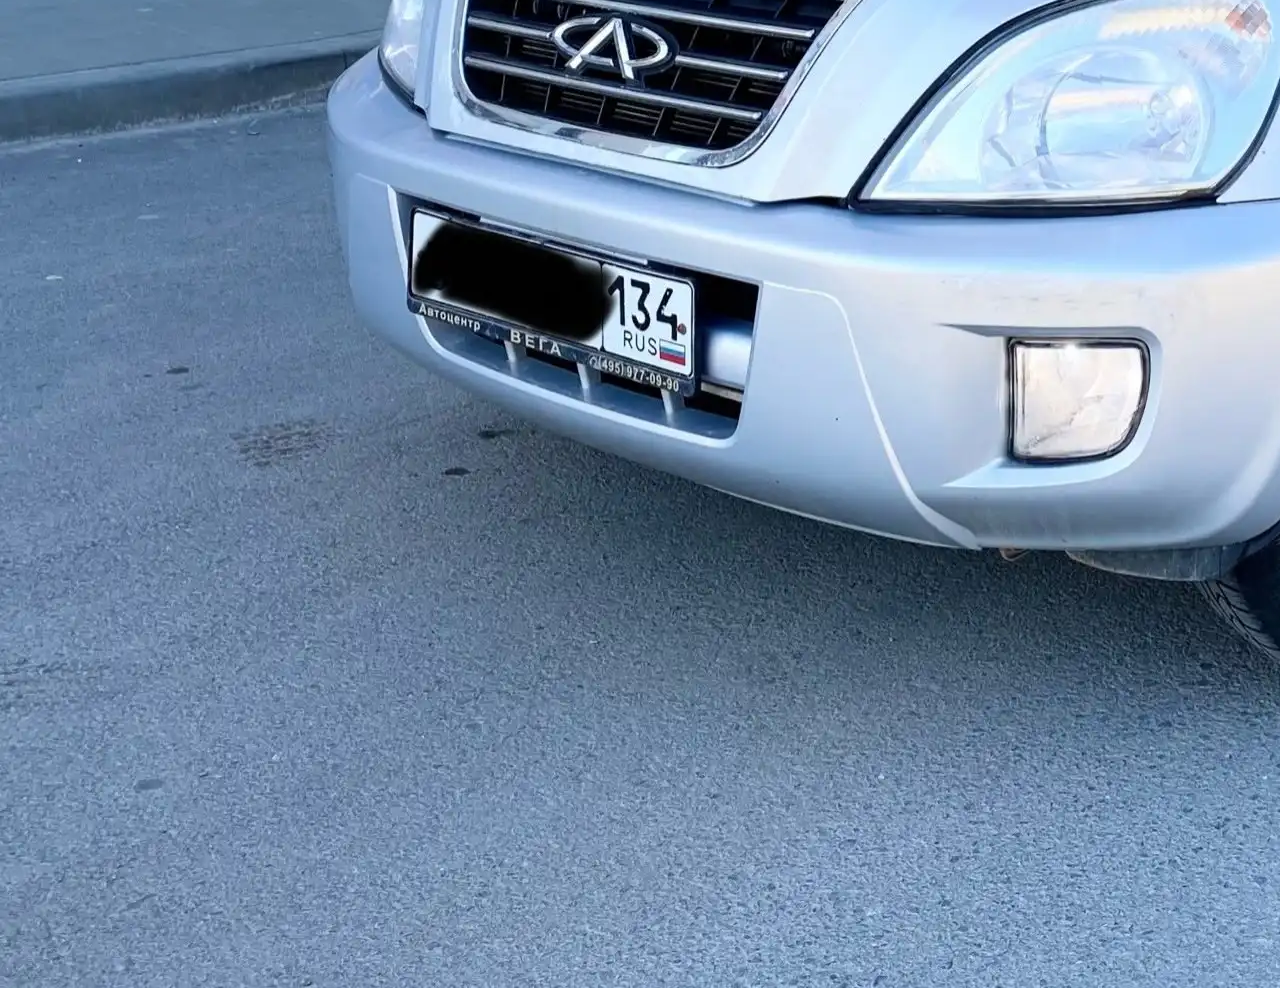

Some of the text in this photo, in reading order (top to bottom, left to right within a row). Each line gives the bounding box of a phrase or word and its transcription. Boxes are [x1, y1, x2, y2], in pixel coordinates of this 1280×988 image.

[418, 302, 481, 333] Автоцентр
[607, 275, 678, 342] 134
[509, 328, 562, 357] ВЕГА
[622, 329, 658, 357] RUS
